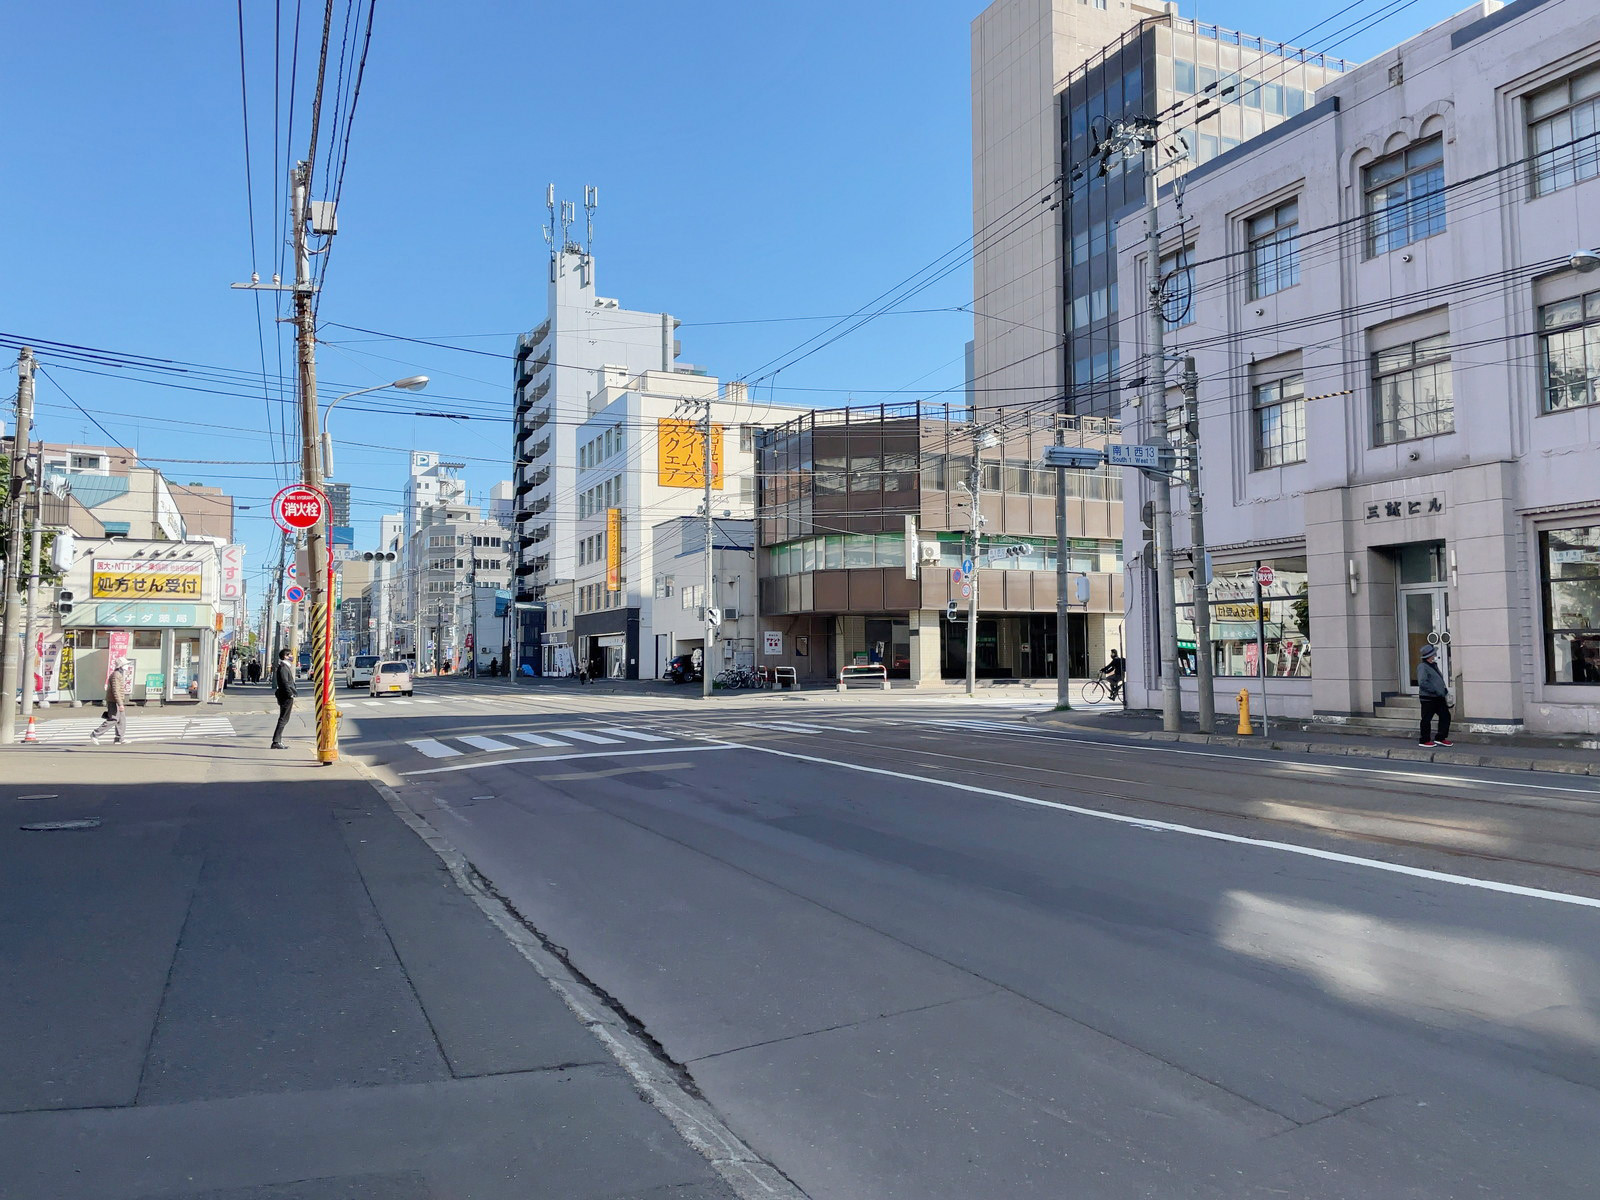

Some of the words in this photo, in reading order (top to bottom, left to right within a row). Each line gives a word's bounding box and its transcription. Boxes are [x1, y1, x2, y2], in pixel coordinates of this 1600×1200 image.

[284, 502, 318, 517] 消火栓
[224, 549, 238, 598] くすり
[97, 577, 197, 594] 処方せん受付
[108, 613, 188, 623] スナダ薬局
